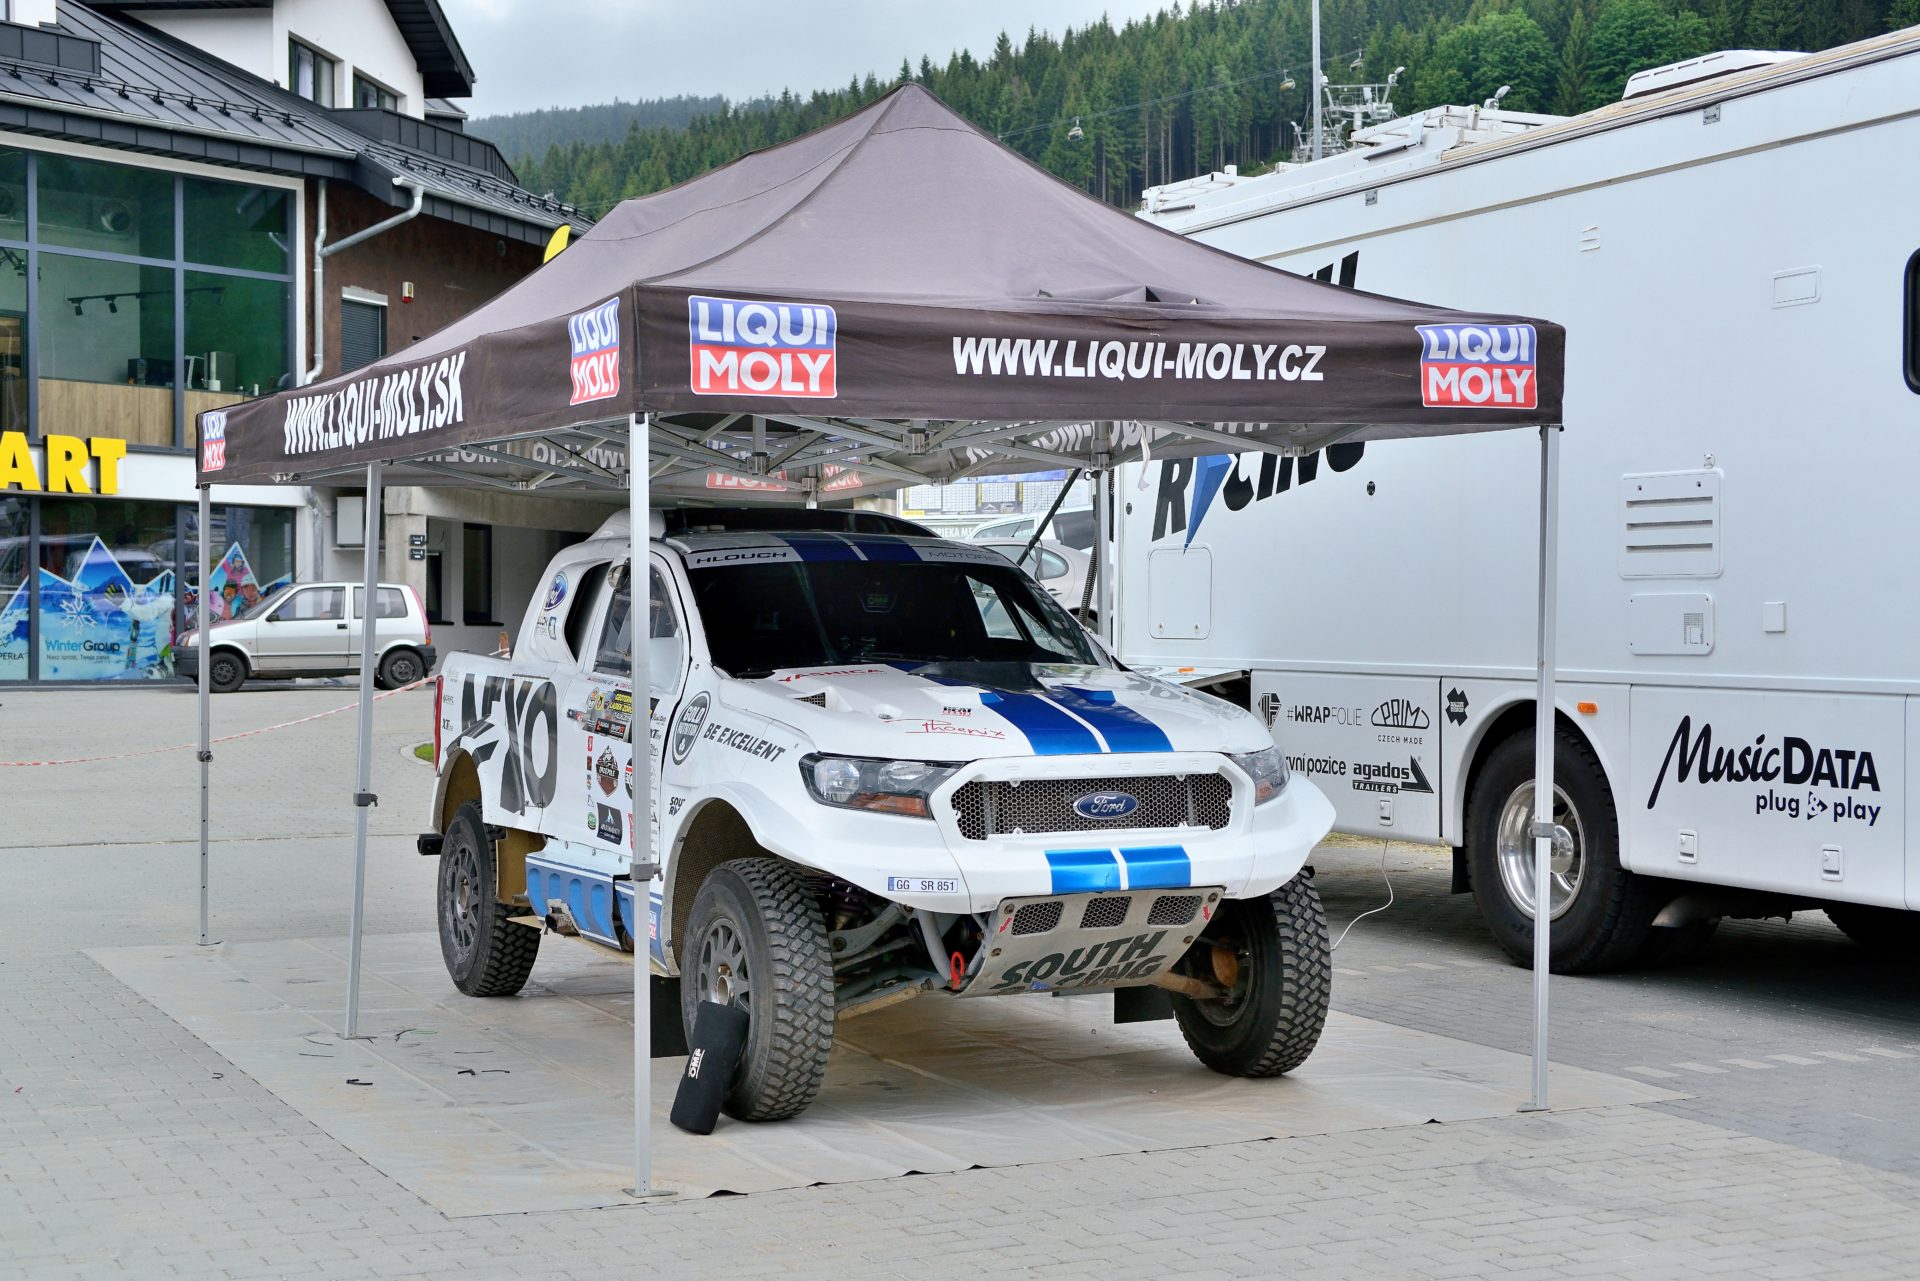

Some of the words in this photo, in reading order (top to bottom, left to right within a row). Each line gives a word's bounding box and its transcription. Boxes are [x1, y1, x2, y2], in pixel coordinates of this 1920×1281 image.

[571, 304, 619, 355] LIQUI
[697, 302, 830, 348] LIQUI
[953, 335, 1327, 383] WWW.LIQUI-MOLY.CZ
[1424, 327, 1530, 362] LIQUI
[571, 352, 618, 400] MOLY
[699, 350, 833, 393] MOLY
[1429, 367, 1533, 403] MOLY
[284, 351, 467, 455] WWW.LIQUI-MOLY.SK
[203, 412, 226, 440] LIQUI
[0, 431, 127, 495] ART
[203, 441, 226, 472] MOLY
[697, 551, 787, 564] HLOUCH
[929, 551, 1000, 562] MOTORS
[1286, 705, 1362, 727] #WRAPFOLIE
[1379, 699, 1421, 728] PRIM
[703, 722, 721, 740] BE
[717, 728, 787, 762] EXCELLENT
[1378, 735, 1400, 744] CZECH
[1403, 736, 1423, 745] MADE
[1307, 755, 1346, 777] pozice
[1353, 763, 1410, 781] agados
[1646, 715, 1881, 809] MusicDATA
[1353, 780, 1399, 794] TRAILERS
[1090, 796, 1127, 814] Ford
[1756, 789, 1800, 818] plug
[1833, 797, 1882, 827] play
[896, 878, 911, 891] GG
[920, 879, 934, 892] SR
[936, 880, 956, 892] 851
[989, 930, 1168, 990] SOUTH
[689, 1048, 704, 1078] OMP
